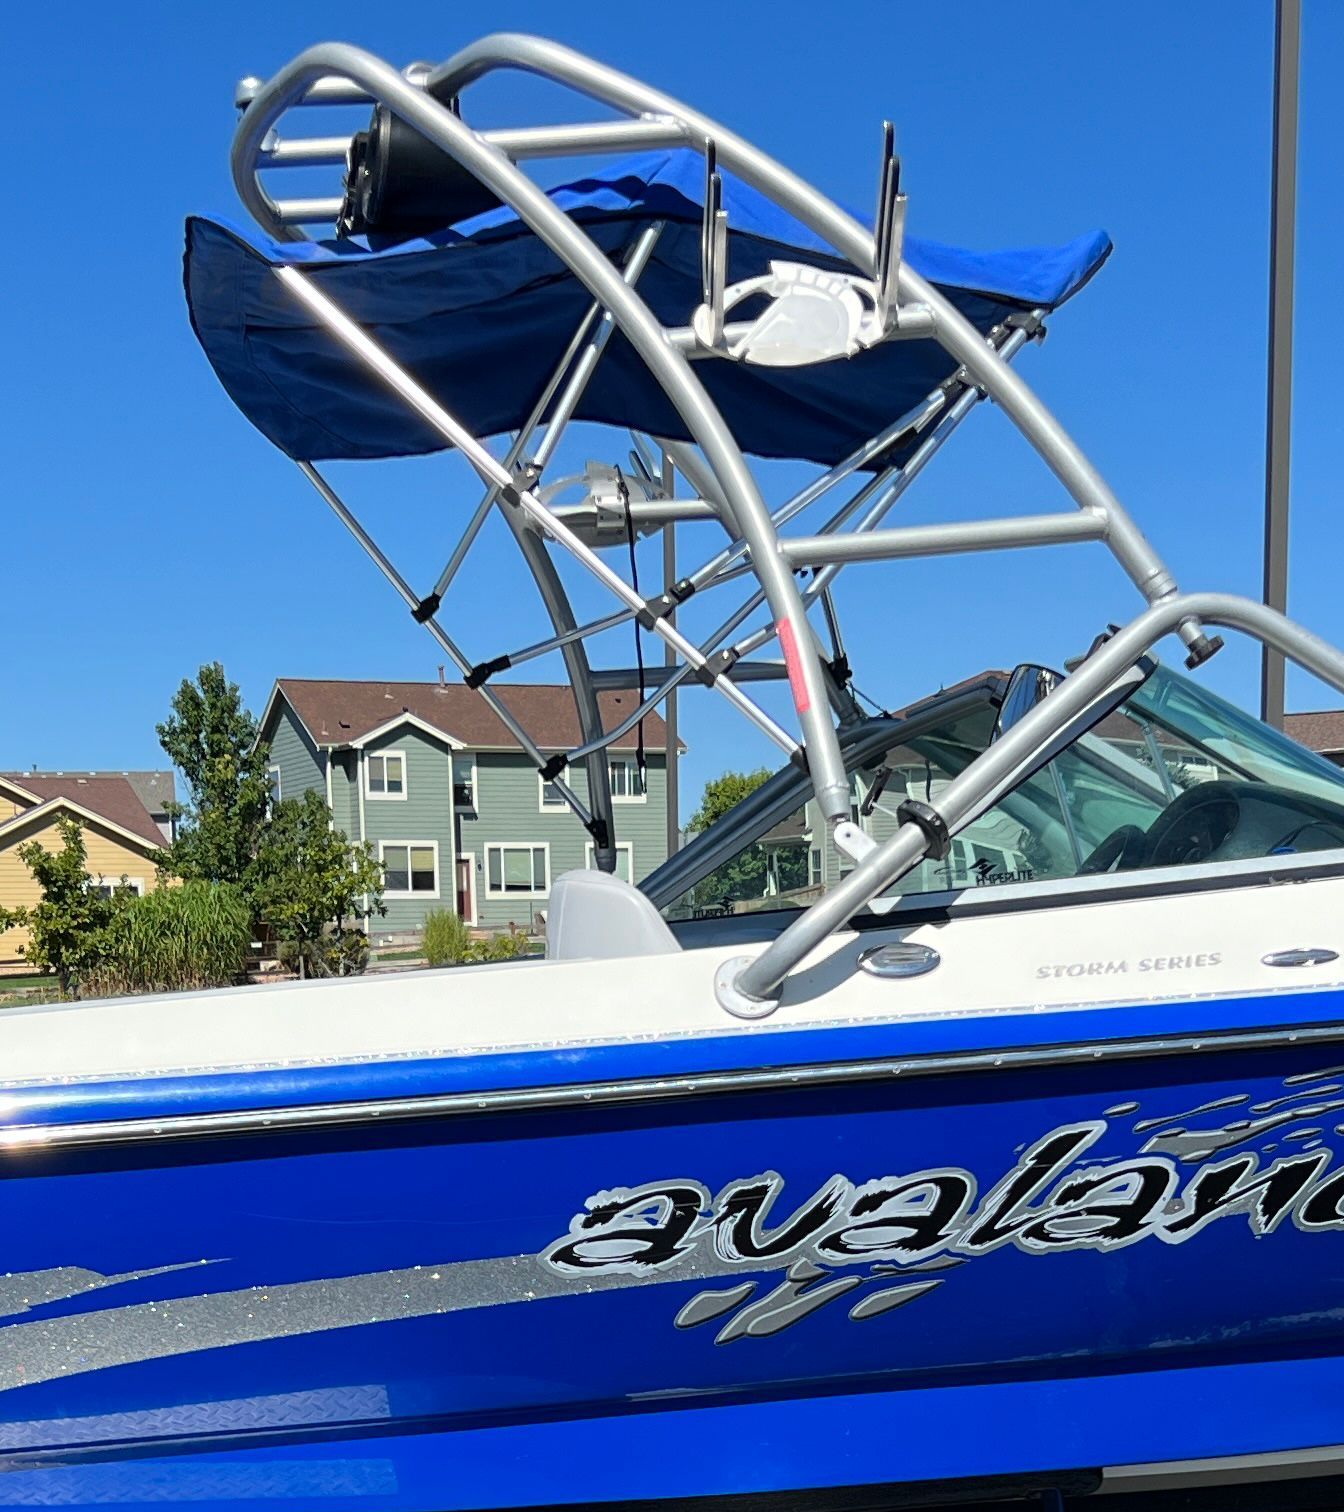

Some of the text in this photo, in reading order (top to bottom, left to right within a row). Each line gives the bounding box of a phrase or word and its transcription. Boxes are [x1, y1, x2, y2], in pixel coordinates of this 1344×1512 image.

[976, 869, 1034, 885] HYPERLITE
[1035, 952, 1223, 980] STORM SERIES
